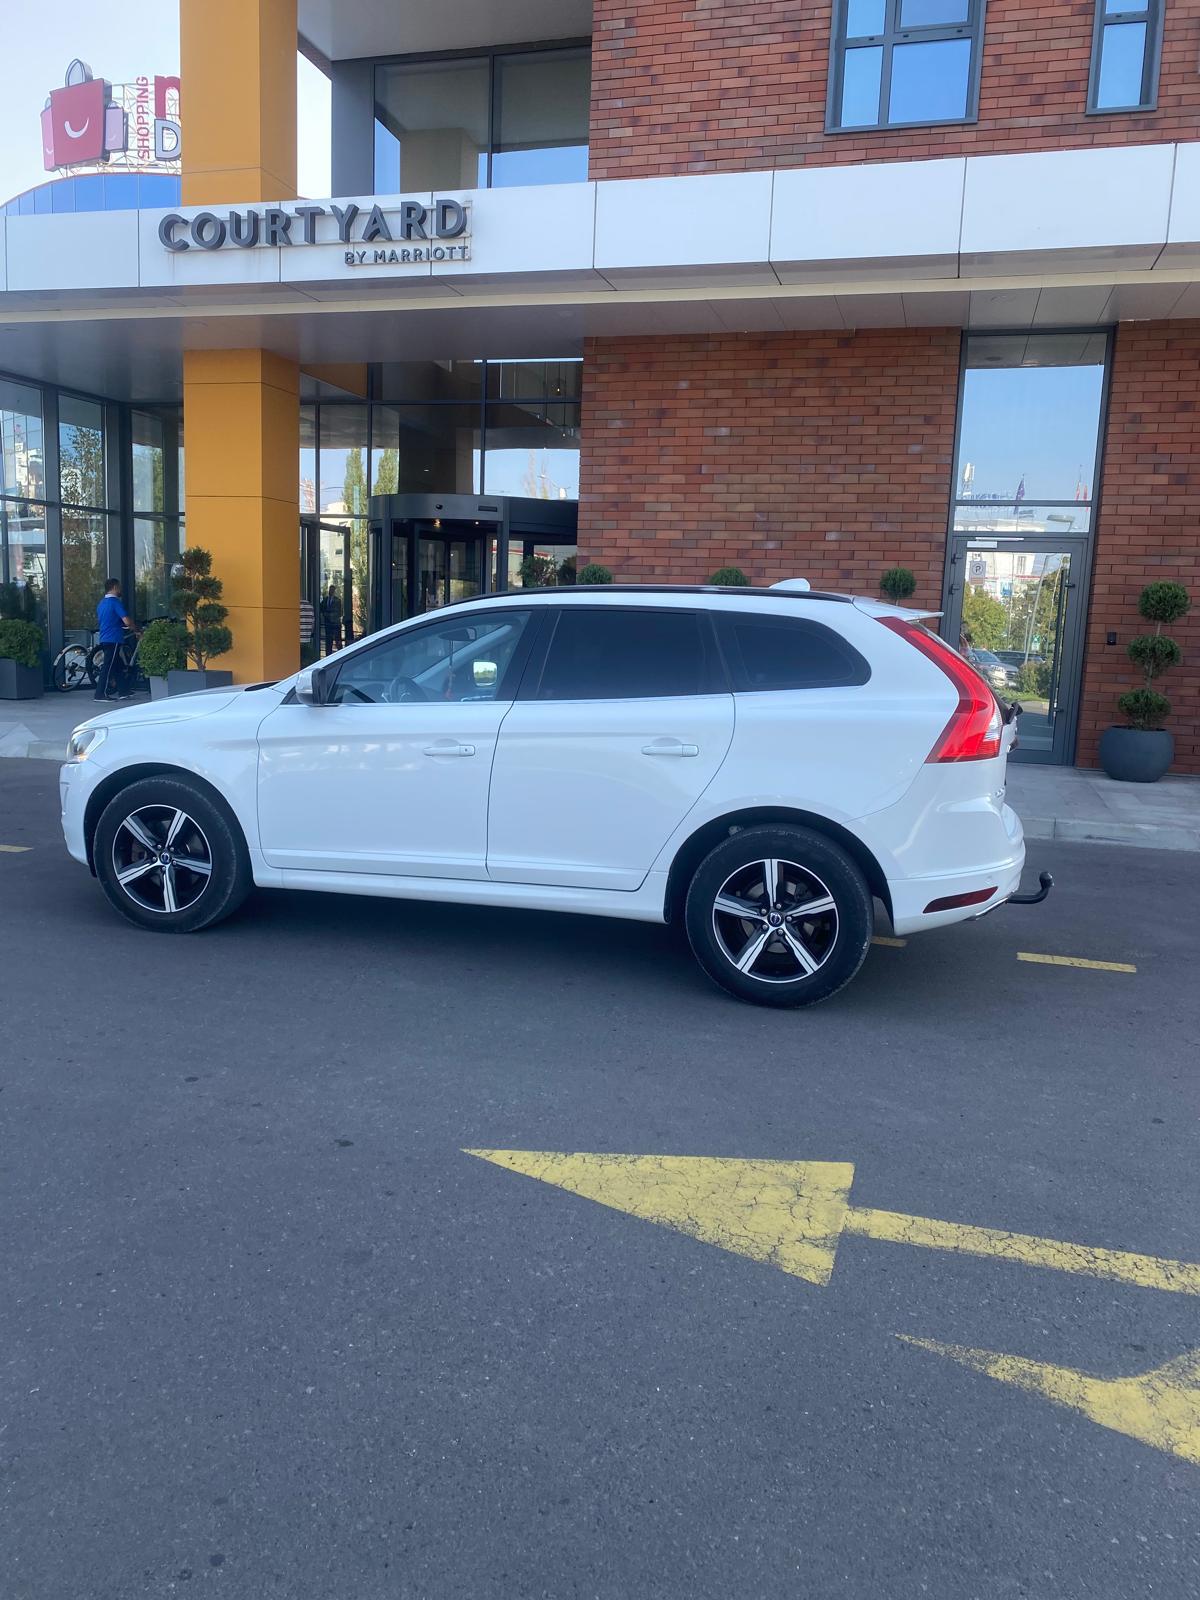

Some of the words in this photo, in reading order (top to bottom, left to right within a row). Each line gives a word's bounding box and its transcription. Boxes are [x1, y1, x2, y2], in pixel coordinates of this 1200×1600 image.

[136, 76, 150, 159] SHOPPING
[158, 199, 468, 251] COURTYARD
[344, 250, 367, 265] BY
[373, 245, 469, 264] MARRIOTT
